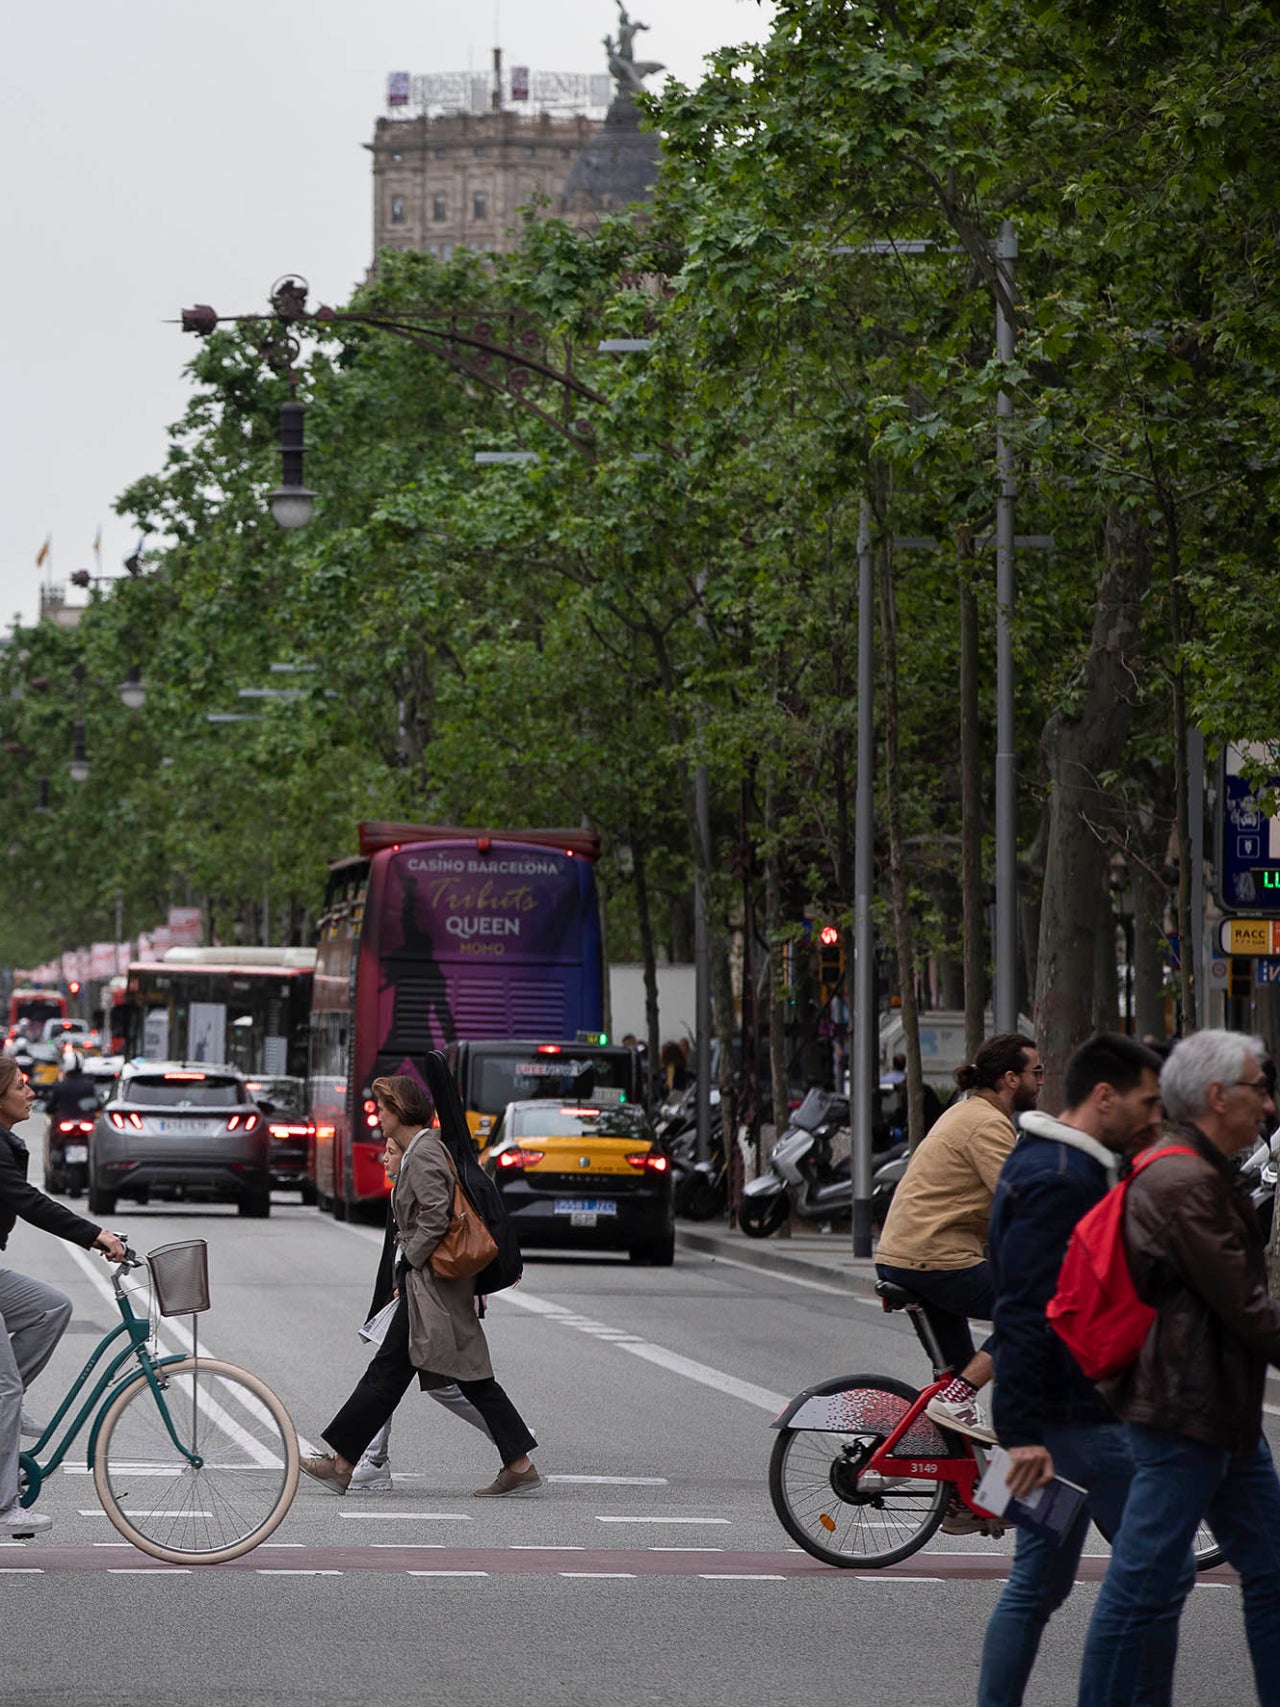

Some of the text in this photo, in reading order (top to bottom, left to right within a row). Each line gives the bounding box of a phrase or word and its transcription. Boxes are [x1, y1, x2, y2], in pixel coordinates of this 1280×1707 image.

[407, 858, 559, 875] CASINO BARCELONA
[445, 916, 520, 939] QUEEN
[1235, 929, 1266, 939] RACC
[911, 1462, 938, 1473] 3149
